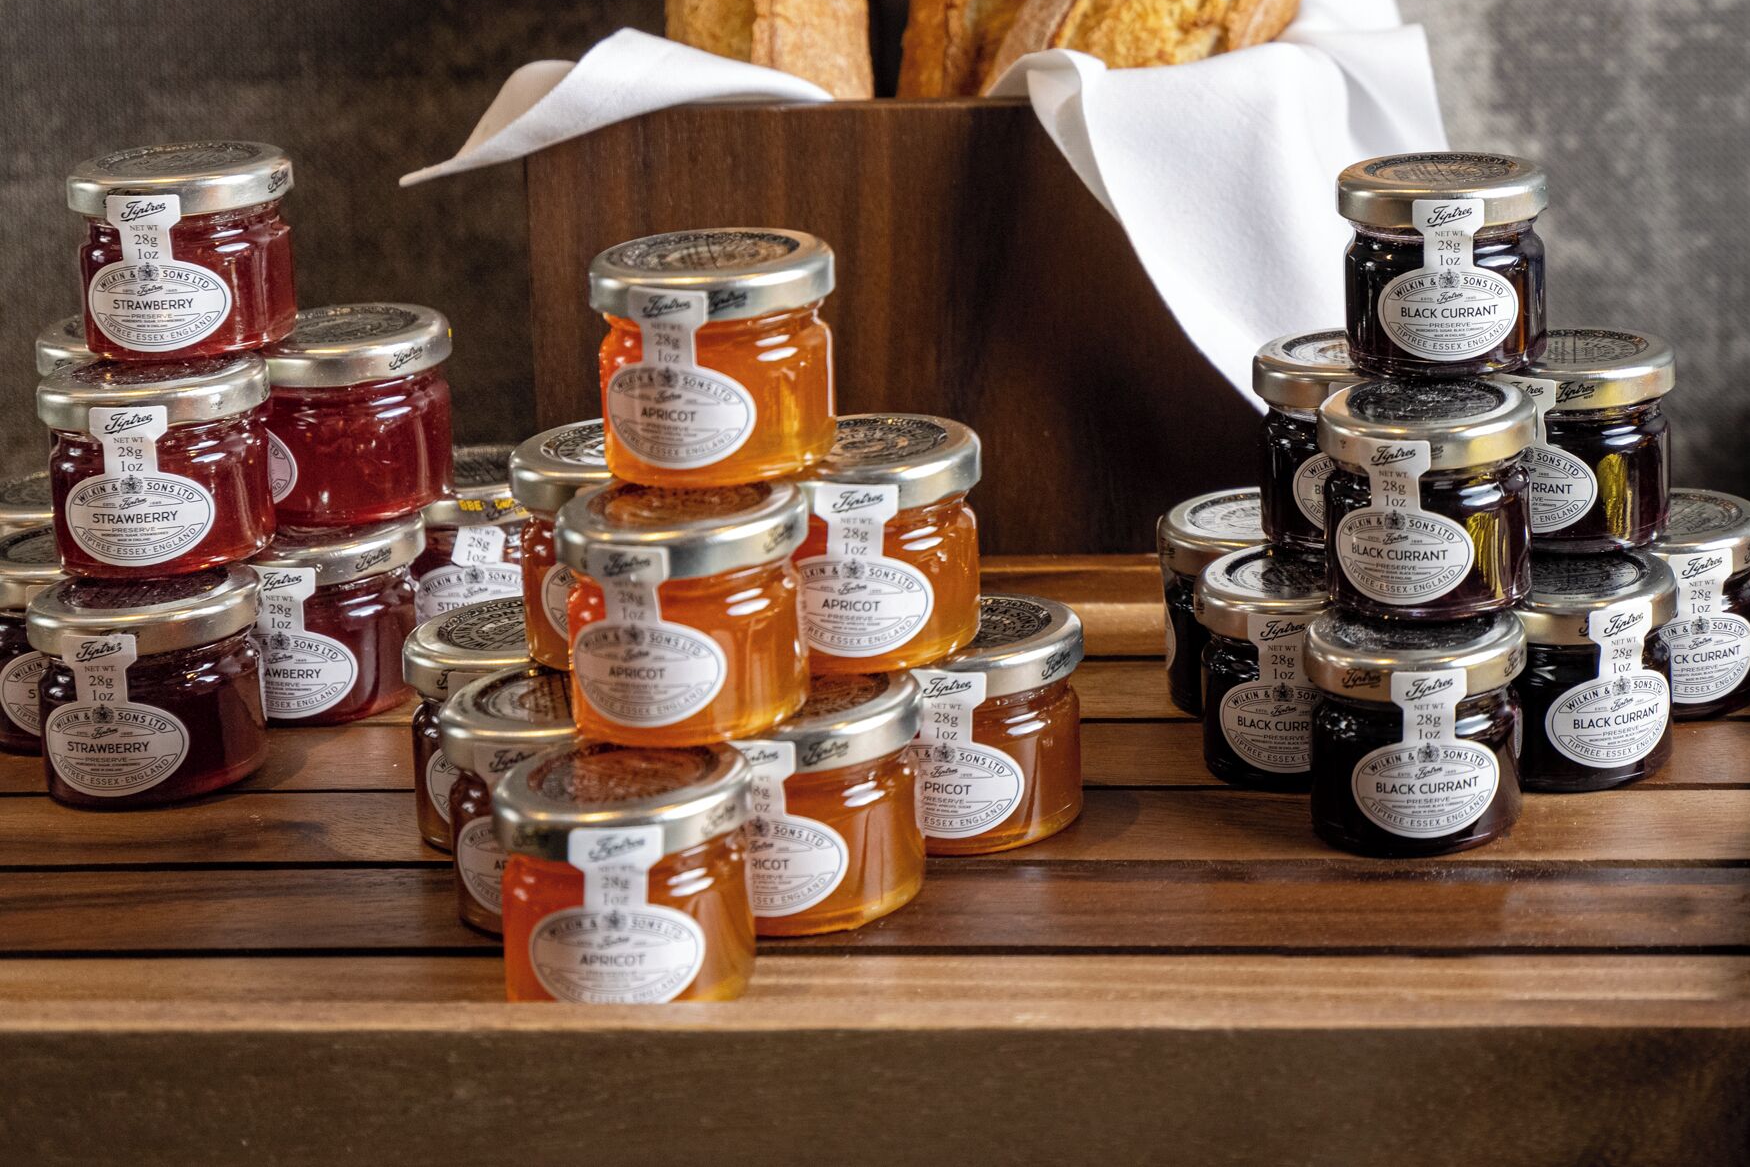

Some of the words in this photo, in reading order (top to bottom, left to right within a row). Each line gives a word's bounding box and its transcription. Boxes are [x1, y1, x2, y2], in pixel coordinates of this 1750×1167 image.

[120, 200, 166, 222] Tiptree
[1426, 205, 1473, 228] Tiptree
[134, 234, 159, 248] 28g
[1437, 240, 1461, 254] 28g
[137, 249, 159, 260] 1oz
[1439, 254, 1461, 266] 1oz
[100, 272, 126, 290] WILKIN
[129, 270, 136, 279] &
[163, 269, 190, 283] SONS
[191, 274, 210, 289] LTD
[1394, 279, 1425, 298] WILKIN
[1429, 277, 1436, 286] &
[1463, 276, 1488, 288] SONS
[1489, 283, 1504, 296] LTD
[113, 298, 194, 311] STRAWBERRY
[1401, 306, 1437, 319] BLACK
[1441, 304, 1499, 319] CURRANT
[640, 406, 697, 422] APRICOT
[103, 412, 153, 435] Tiptree
[117, 446, 144, 459] 28g
[1370, 445, 1416, 466] Tiptree
[120, 461, 144, 472] 1oz
[77, 485, 107, 504] WILKIN
[111, 483, 118, 492] &
[146, 482, 175, 493] SONS
[177, 488, 195, 501] LTD
[1382, 480, 1407, 495] 28g
[831, 489, 884, 513] Tiptree
[1384, 494, 1407, 508] 1oz
[92, 510, 179, 525] STRAWBERRY
[840, 517, 857, 525] NET
[842, 527, 869, 543] 28g
[1346, 517, 1372, 533] WILKIN
[1376, 517, 1383, 525] &
[1408, 519, 1435, 533] SONS
[1438, 527, 1455, 542] LTD
[844, 543, 868, 556] 1oz
[1351, 543, 1384, 559] BLACK
[1386, 549, 1449, 562] CURRANT
[263, 572, 303, 592] Tiptree
[802, 568, 826, 578] LKIN
[831, 567, 839, 575] &
[869, 568, 896, 584] SONS
[898, 576, 914, 591] LTD
[268, 604, 292, 617] 28g
[821, 598, 881, 613] APRICOT
[271, 617, 292, 629] 1oz
[1603, 611, 1644, 638] Tiptree
[293, 639, 320, 652] SONS
[322, 646, 339, 660] LTD
[1611, 647, 1633, 660] 28g
[1692, 644, 1741, 663] CURRANT
[265, 668, 322, 679] AWBERRY
[608, 667, 666, 680] APRICOT
[1612, 662, 1632, 674] 1oz
[88, 675, 115, 689] 28g
[922, 676, 972, 699] Tiptree
[1404, 676, 1454, 701] Tiptree
[92, 689, 115, 701] 1oz
[1566, 690, 1599, 711] WILKIN
[1604, 687, 1610, 695] &
[1633, 681, 1653, 689] SONS
[1653, 682, 1664, 694] LTD
[55, 713, 80, 729] WILKIN
[117, 713, 146, 724] SONS
[148, 717, 168, 731] LTD
[1237, 715, 1272, 731] BLACK
[1416, 714, 1442, 728] 28g
[1573, 716, 1611, 730] BLACK
[1614, 702, 1660, 726] CURRANT
[1418, 728, 1441, 740] 1oz
[67, 741, 150, 754] STRAWBERRY
[1370, 754, 1402, 772] WILKIN
[1407, 753, 1415, 761] &
[1443, 750, 1469, 761] SONS
[1469, 753, 1485, 767] LTD
[923, 781, 972, 795] PRICOT
[1375, 782, 1416, 794] BLACK
[1419, 776, 1479, 794] CURRANT
[579, 953, 647, 967] APRICOT
